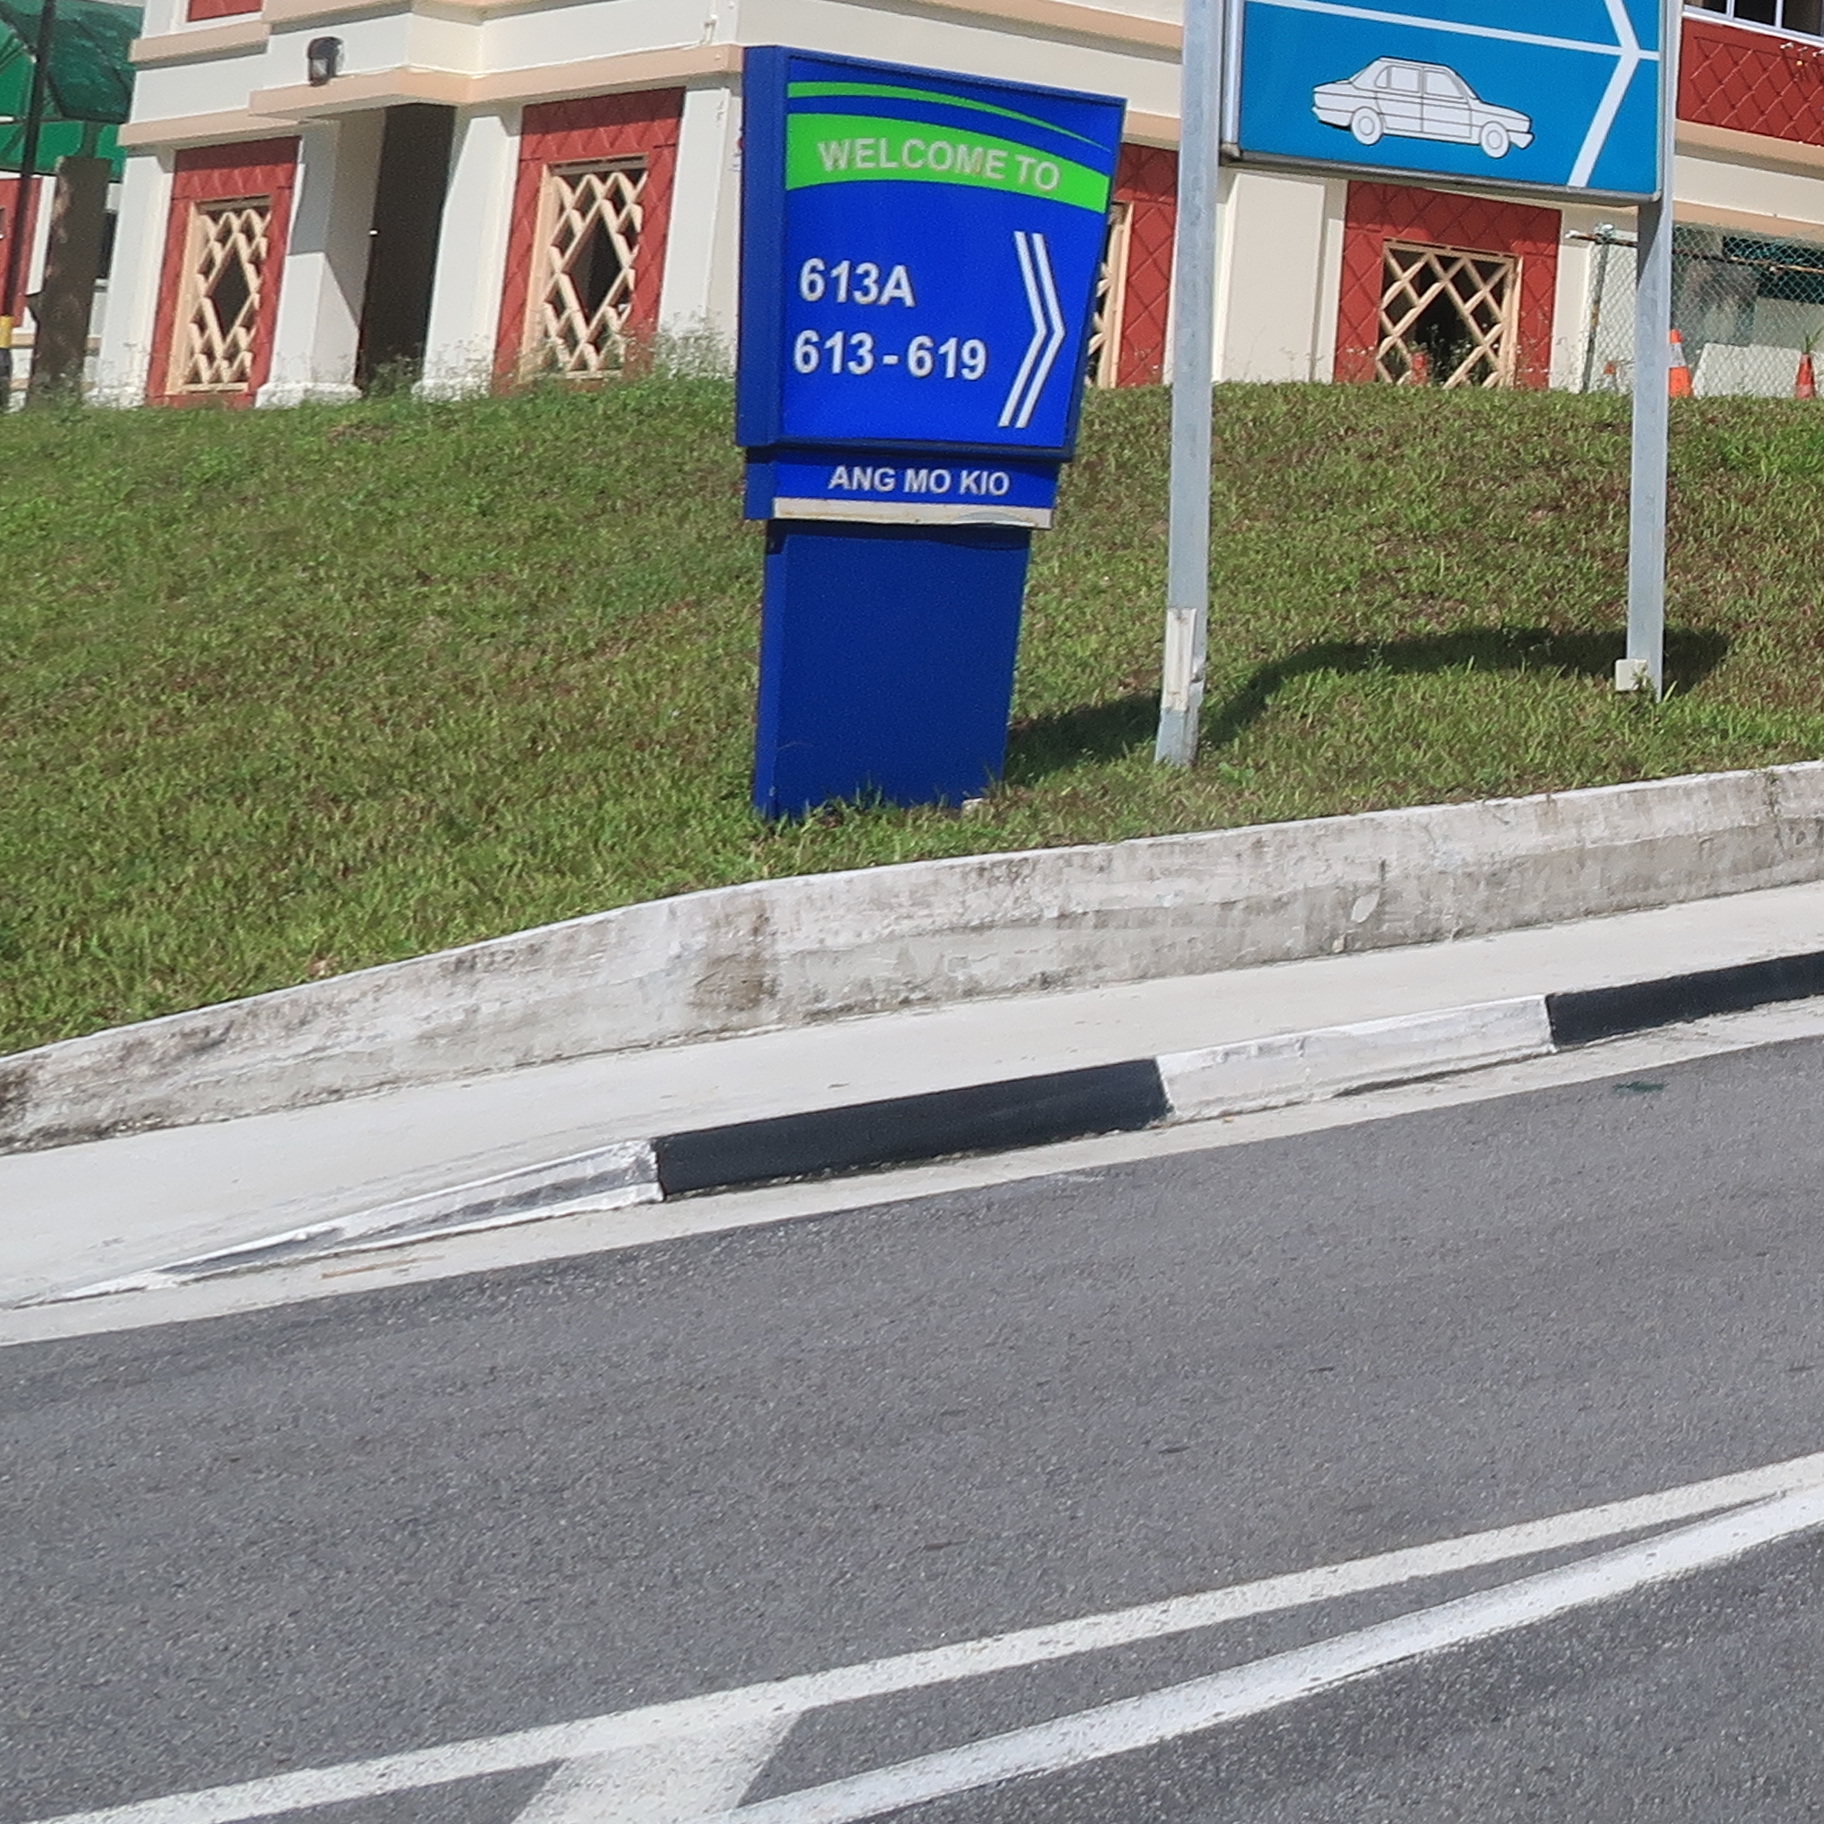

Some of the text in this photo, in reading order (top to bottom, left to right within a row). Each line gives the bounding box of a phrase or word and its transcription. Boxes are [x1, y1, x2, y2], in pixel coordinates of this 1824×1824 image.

[817, 137, 1061, 193] WELCOME TO
[798, 257, 917, 309] 613A
[828, 465, 1011, 496] ANG MO KIO
